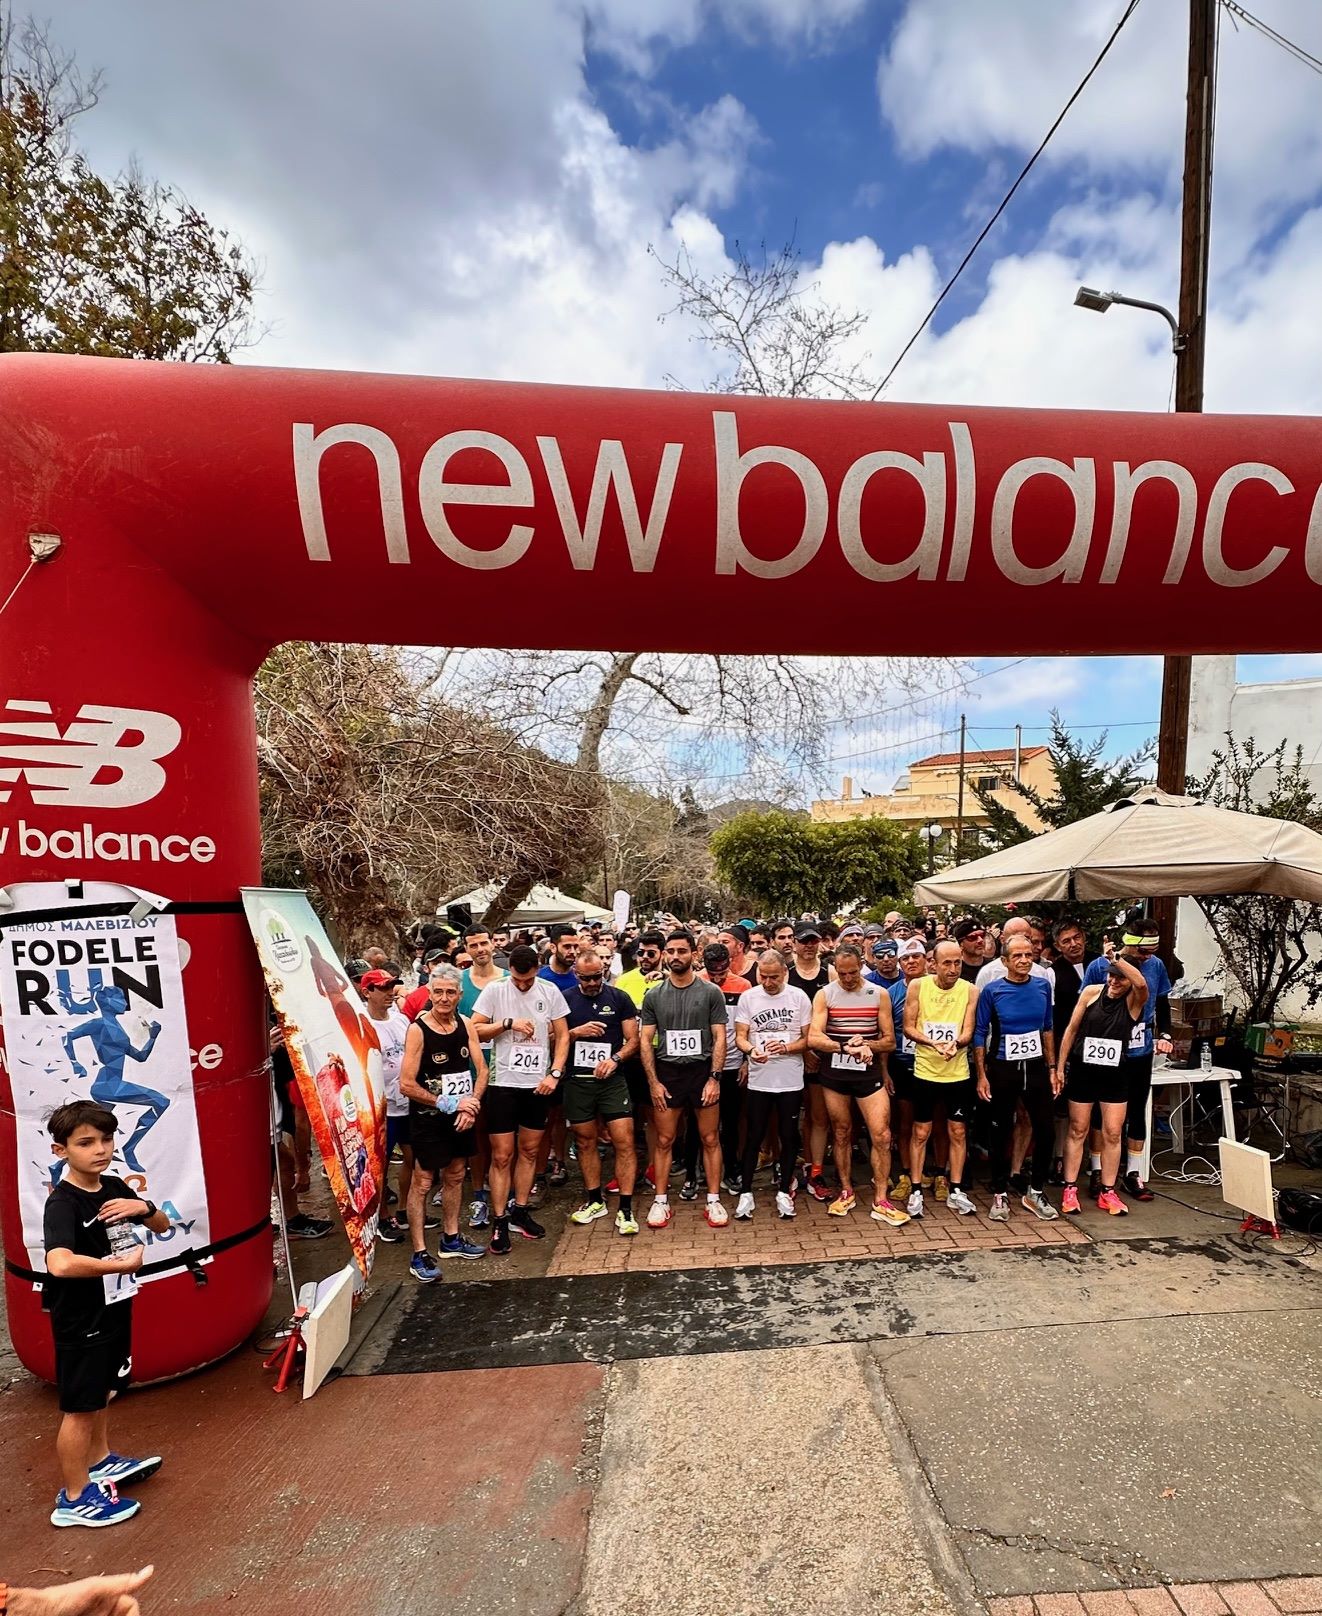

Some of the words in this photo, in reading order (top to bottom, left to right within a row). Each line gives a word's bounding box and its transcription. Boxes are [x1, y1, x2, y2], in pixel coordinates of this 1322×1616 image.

[293, 422, 683, 572] new
[712, 411, 1322, 588] balanc
[18, 819, 216, 863] balance
[11, 935, 158, 966] FODELE
[15, 964, 164, 1016] RUN
[927, 1029, 954, 1042] 126
[671, 1037, 697, 1051] 150
[1010, 1039, 1038, 1055] 253
[1087, 1044, 1117, 1060] 290
[513, 1053, 540, 1068] 204
[579, 1048, 607, 1063] 146
[447, 1079, 471, 1096] 223
